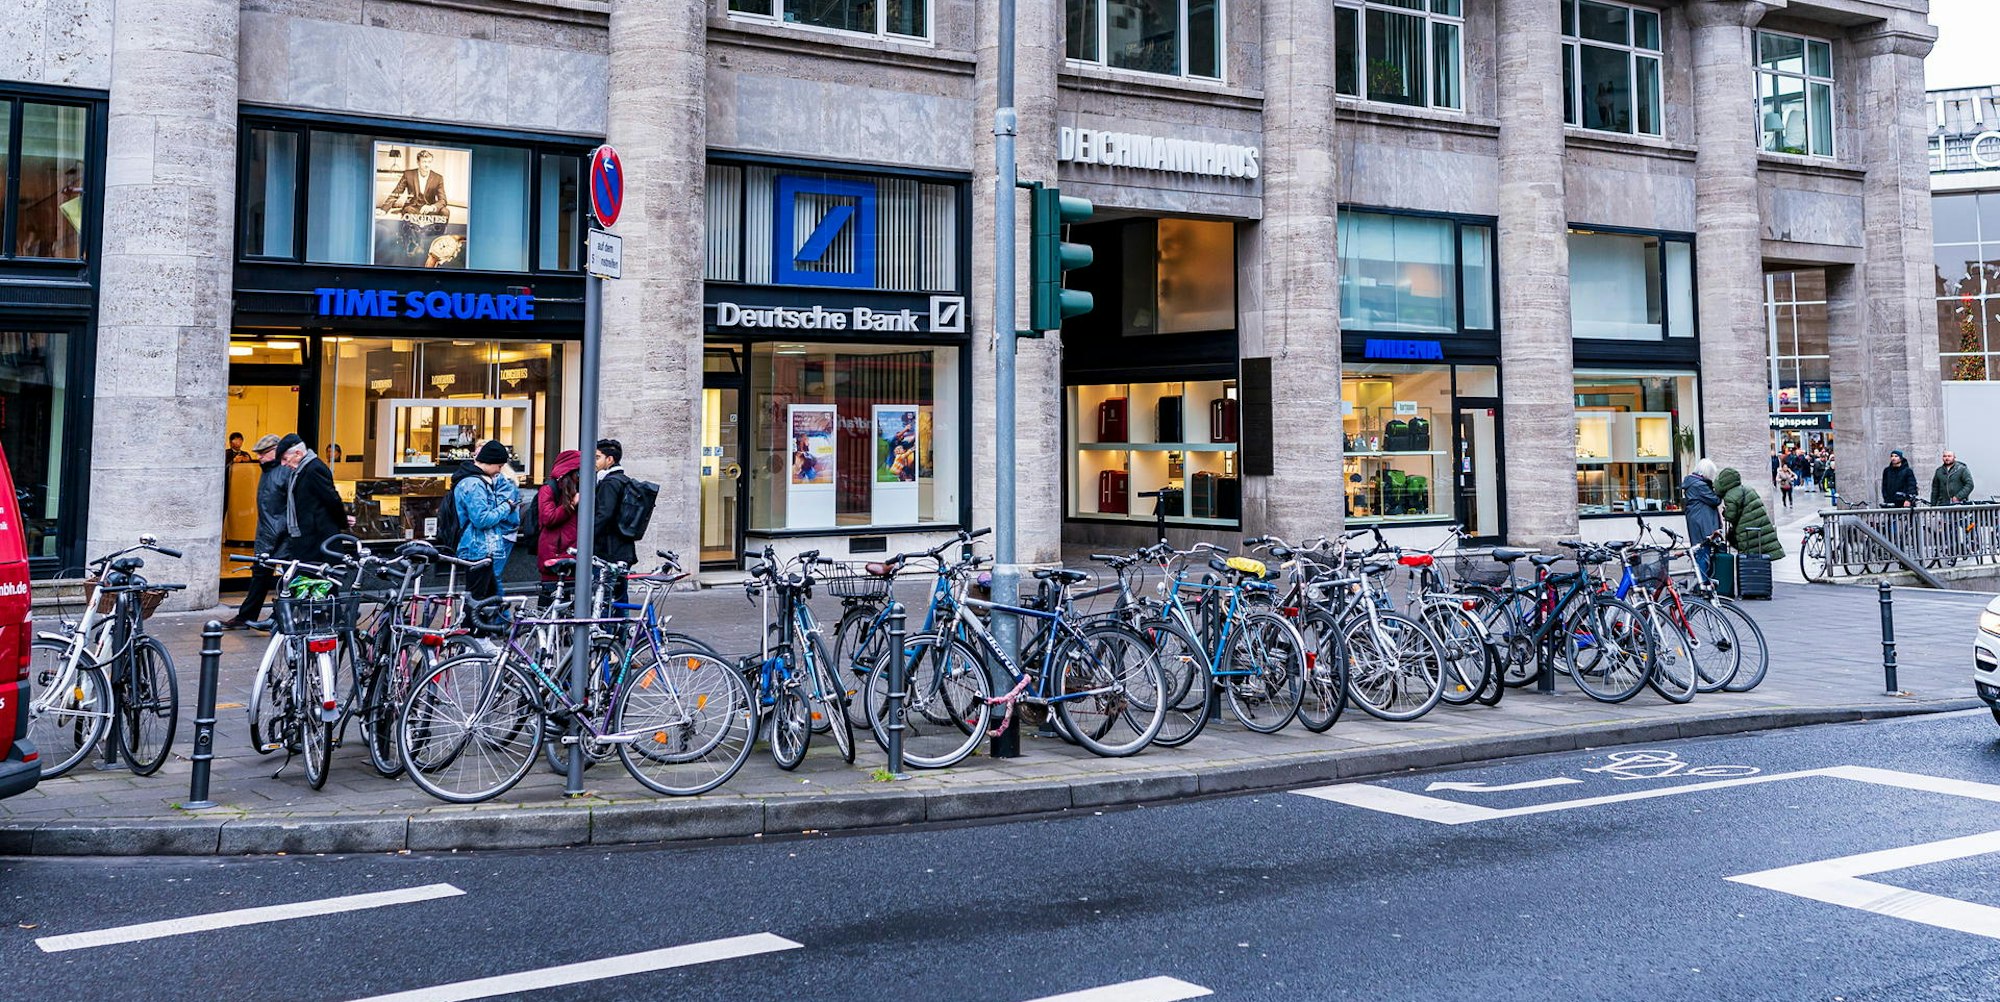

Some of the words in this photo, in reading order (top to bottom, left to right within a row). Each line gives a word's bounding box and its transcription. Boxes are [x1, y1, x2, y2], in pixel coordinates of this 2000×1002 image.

[1058, 126, 1259, 179] DEICHMANNHAUS
[315, 288, 397, 317] TIME
[405, 290, 535, 320] SQUARE
[716, 302, 847, 330] Deutsche
[852, 307, 920, 332] Bank
[1364, 339, 1443, 359] MILLENIA
[1769, 417, 1819, 428] Highspeed
